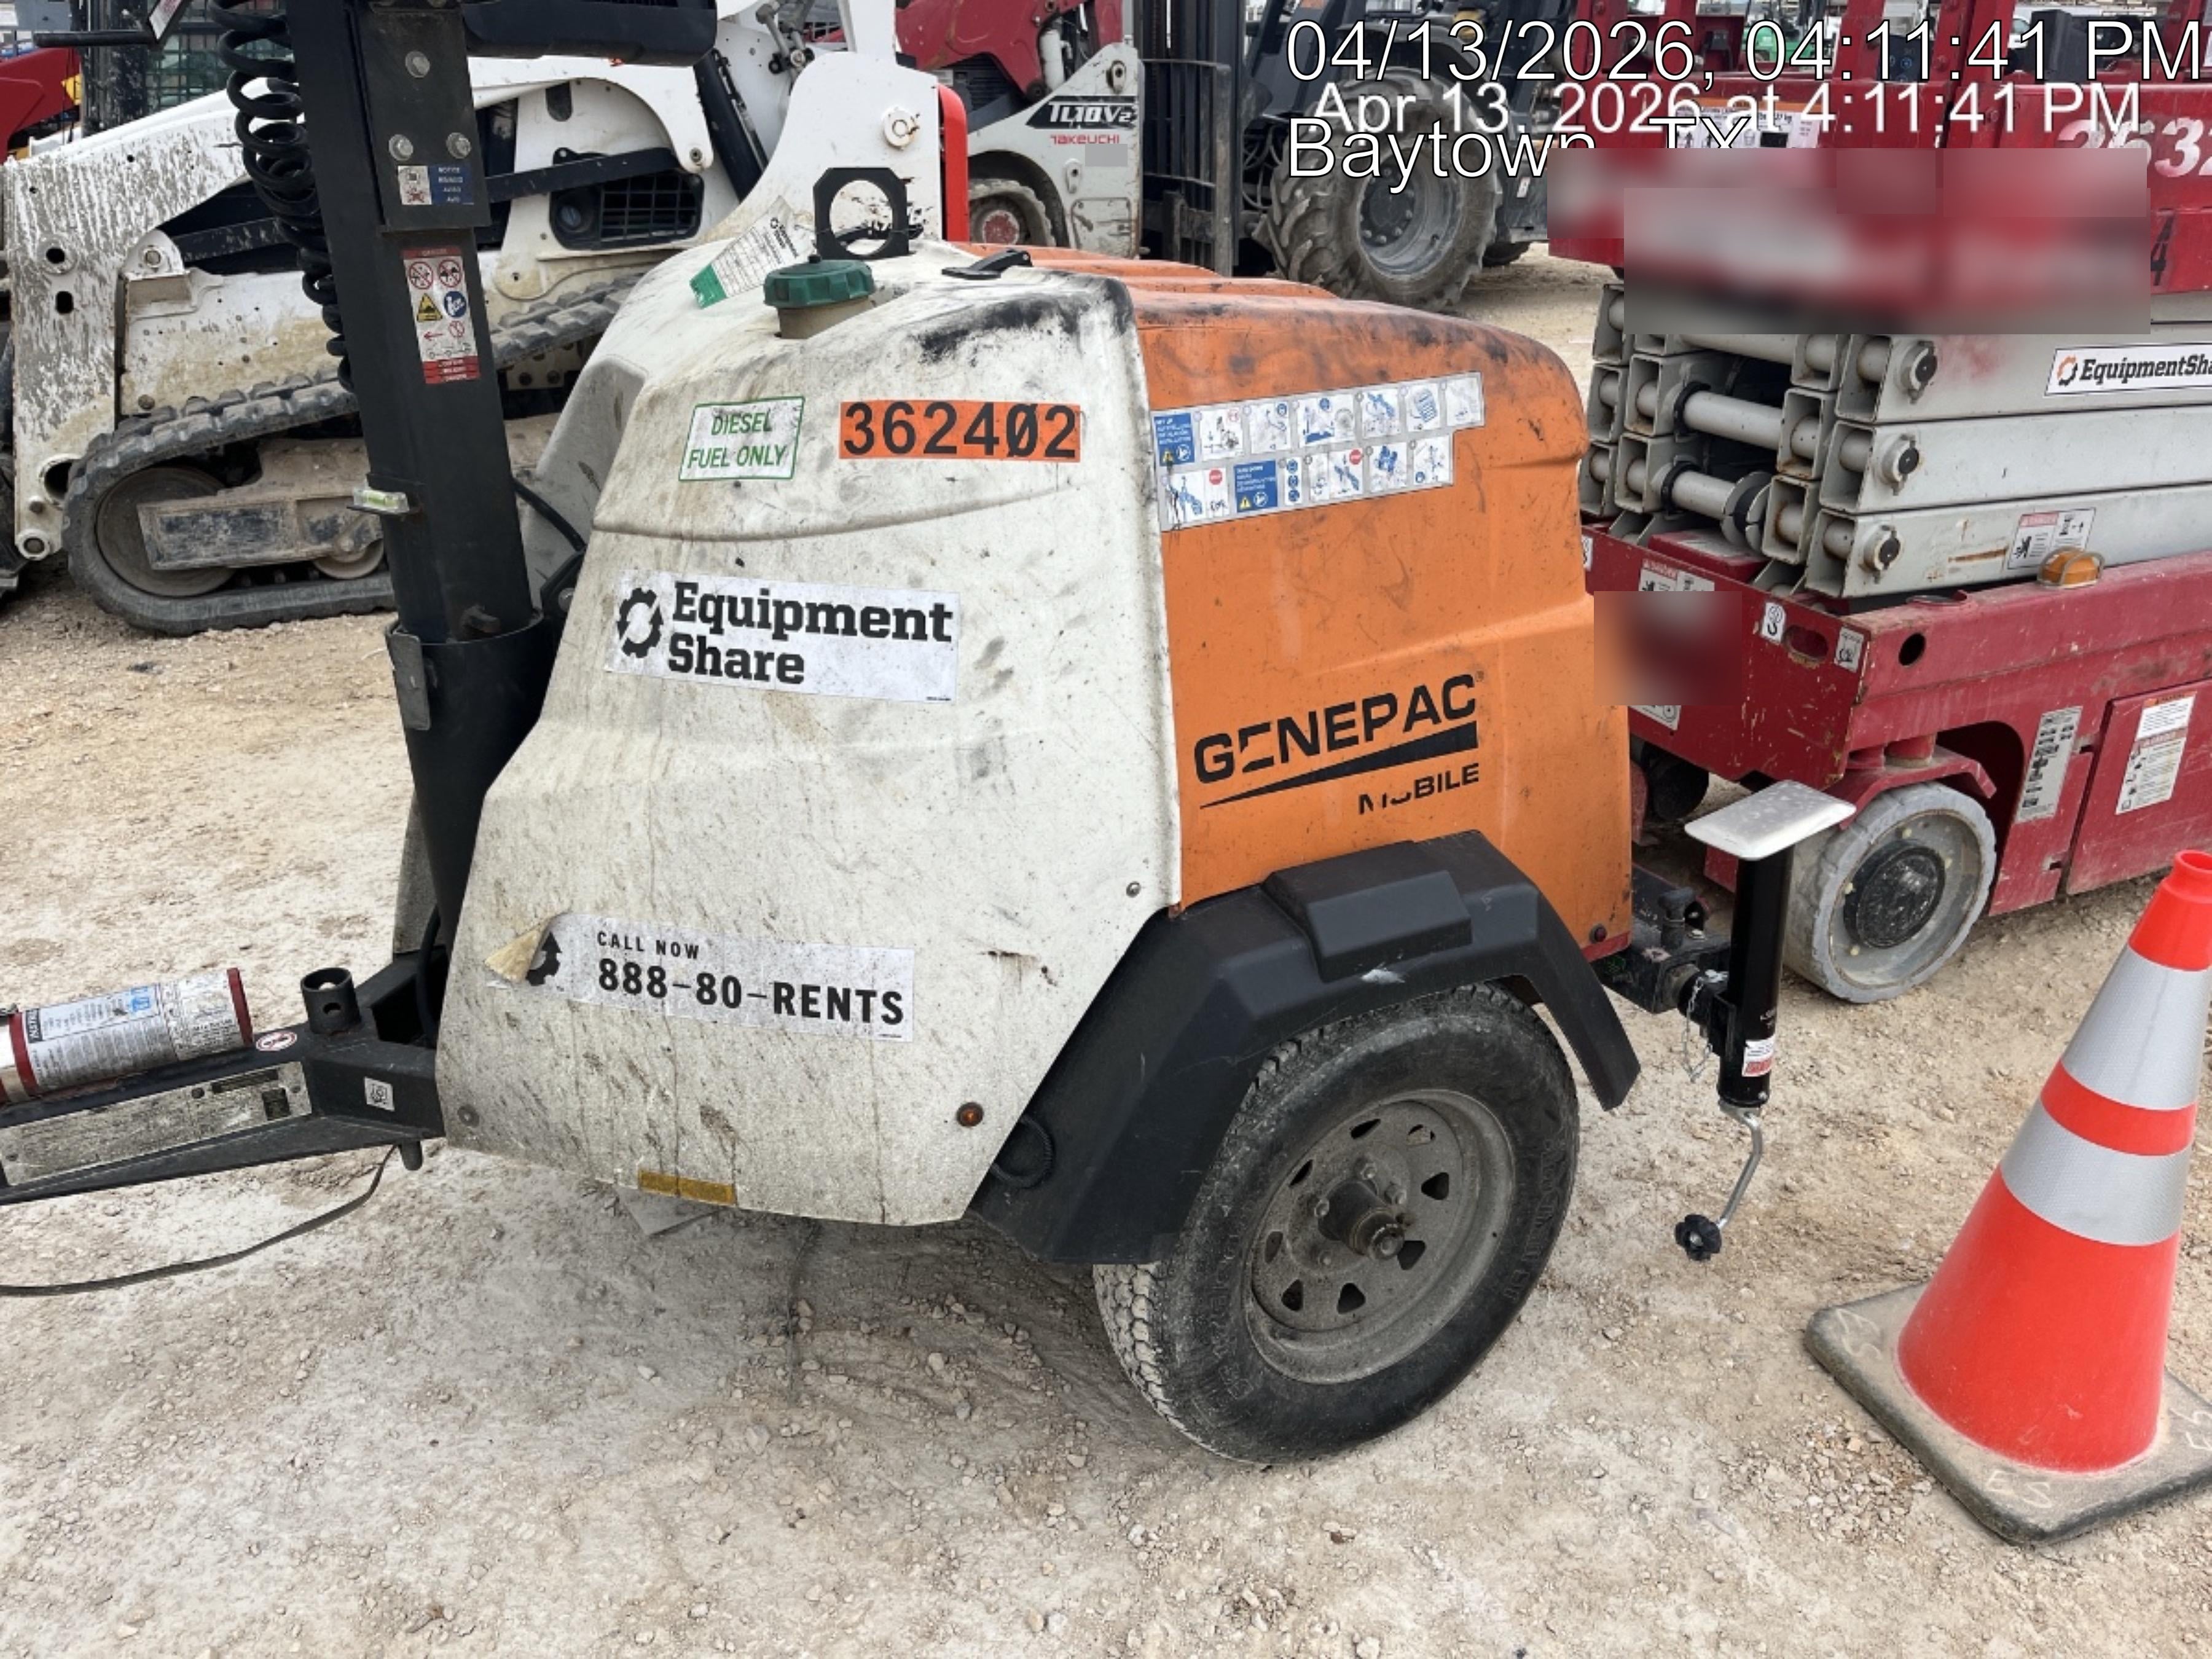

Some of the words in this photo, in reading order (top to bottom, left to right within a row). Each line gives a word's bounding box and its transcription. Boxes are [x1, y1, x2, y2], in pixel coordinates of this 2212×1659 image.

[711, 411, 771, 435] DIESEL
[688, 447, 730, 469] FUEL
[736, 444, 787, 467] ONLY
[672, 581, 953, 641] Equipment
[668, 633, 804, 684] Share
[596, 931, 645, 954] CALL
[655, 939, 699, 960] NOW
[598, 957, 904, 1026] 888-80-RENTS
